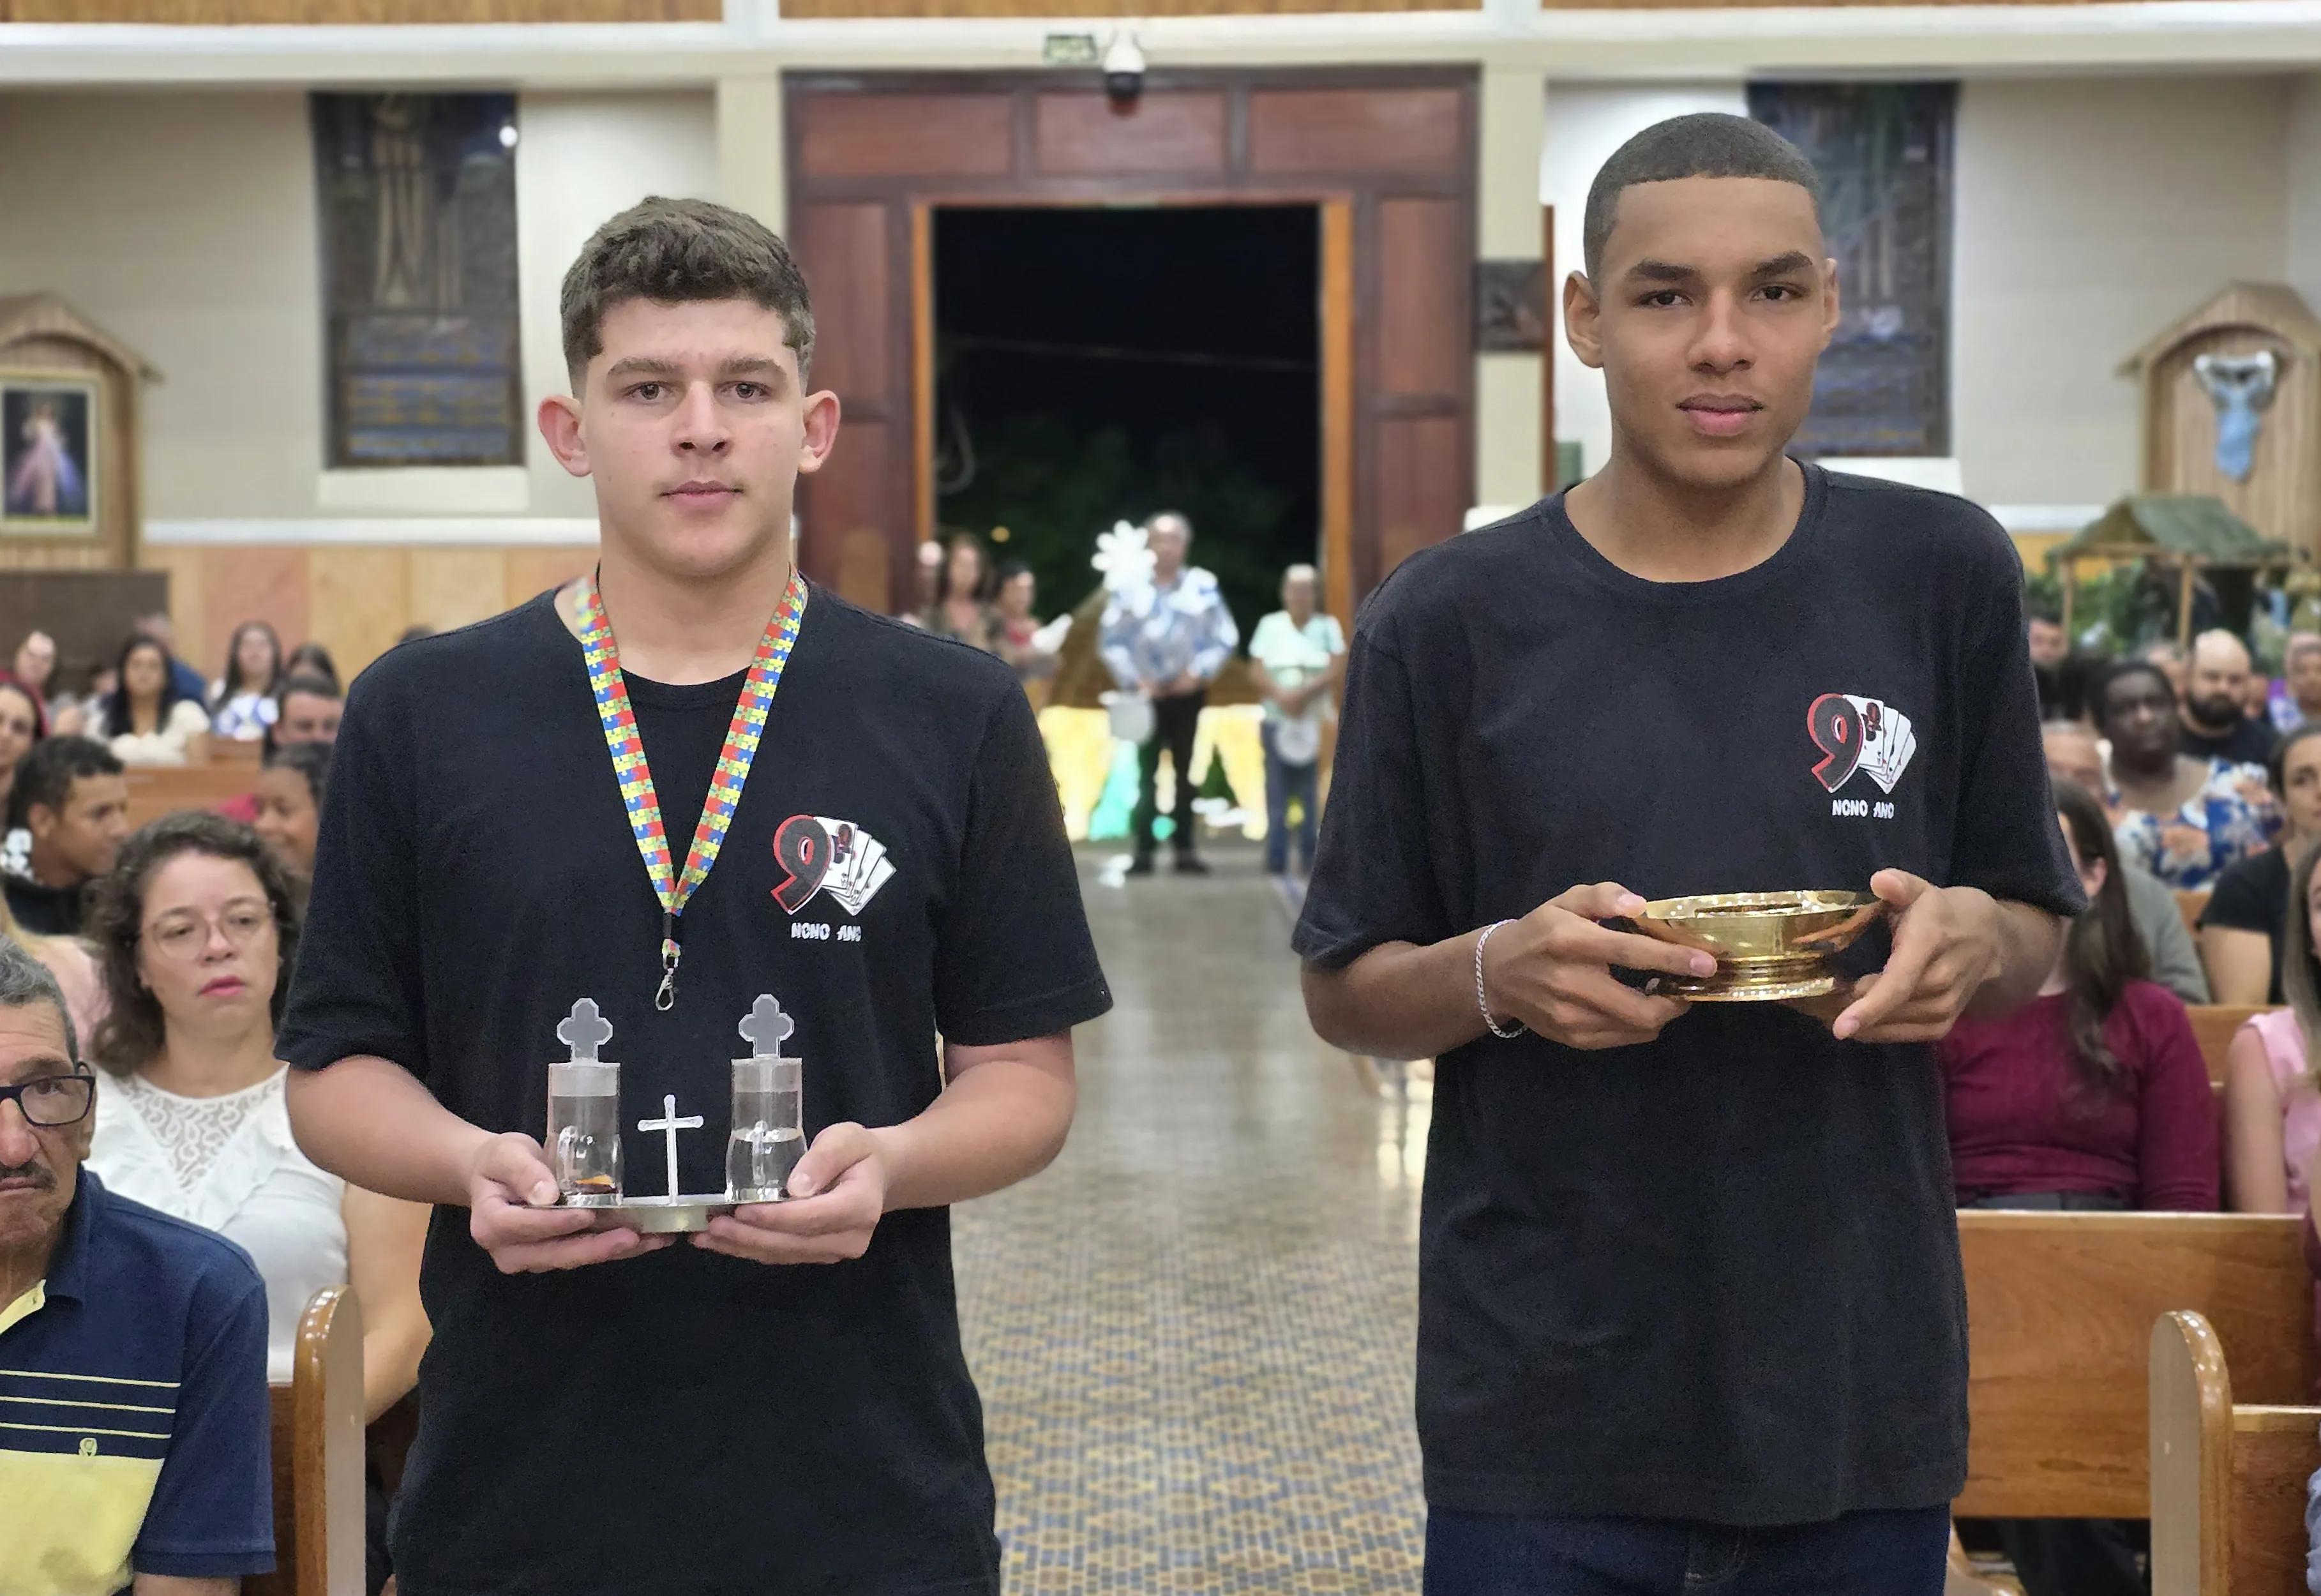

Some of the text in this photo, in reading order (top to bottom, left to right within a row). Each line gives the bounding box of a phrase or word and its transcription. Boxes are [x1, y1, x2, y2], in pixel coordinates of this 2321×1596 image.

[1806, 693, 1865, 794] 9
[1832, 799, 1895, 819] NONO ANO
[770, 814, 834, 915] 9
[791, 922, 830, 940] NONO
